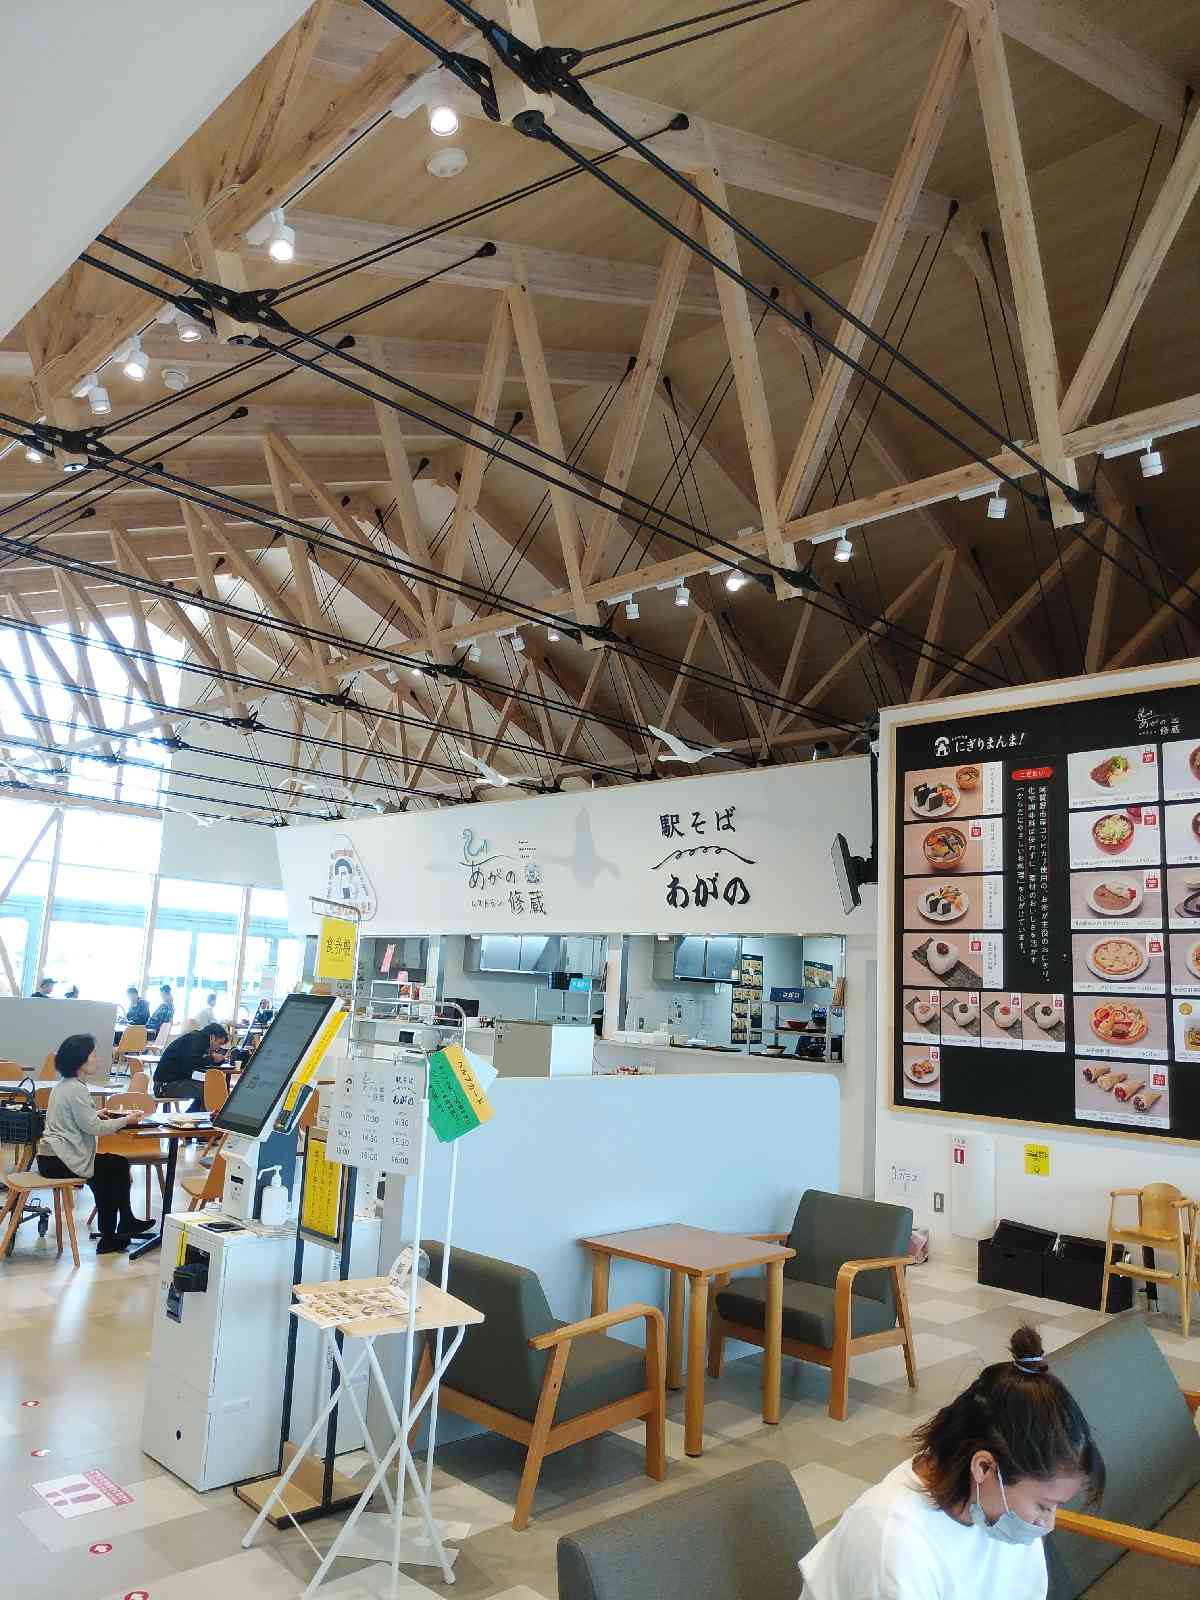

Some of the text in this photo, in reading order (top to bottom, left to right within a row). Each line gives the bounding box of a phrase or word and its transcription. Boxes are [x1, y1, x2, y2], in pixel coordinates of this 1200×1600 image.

[659, 805, 737, 839] 駅そば
[469, 860, 517, 891] あがの
[508, 889, 547, 916] 修蔵
